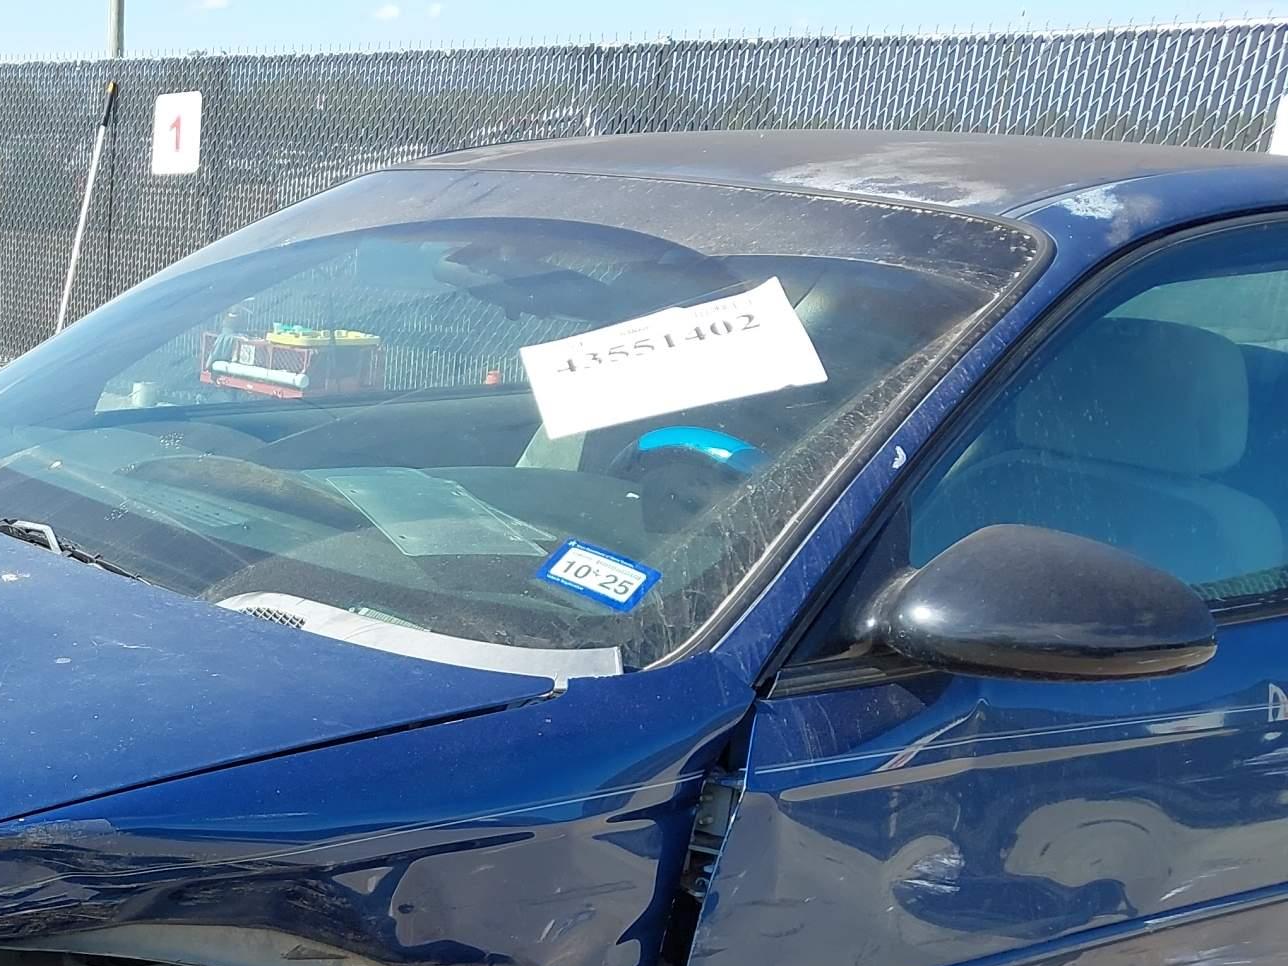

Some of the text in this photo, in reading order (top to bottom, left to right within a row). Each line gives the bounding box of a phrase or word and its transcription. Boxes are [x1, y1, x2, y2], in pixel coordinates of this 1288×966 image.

[169, 113, 181, 152] 1
[556, 314, 760, 373] 43551402
[598, 575, 634, 596] 25
